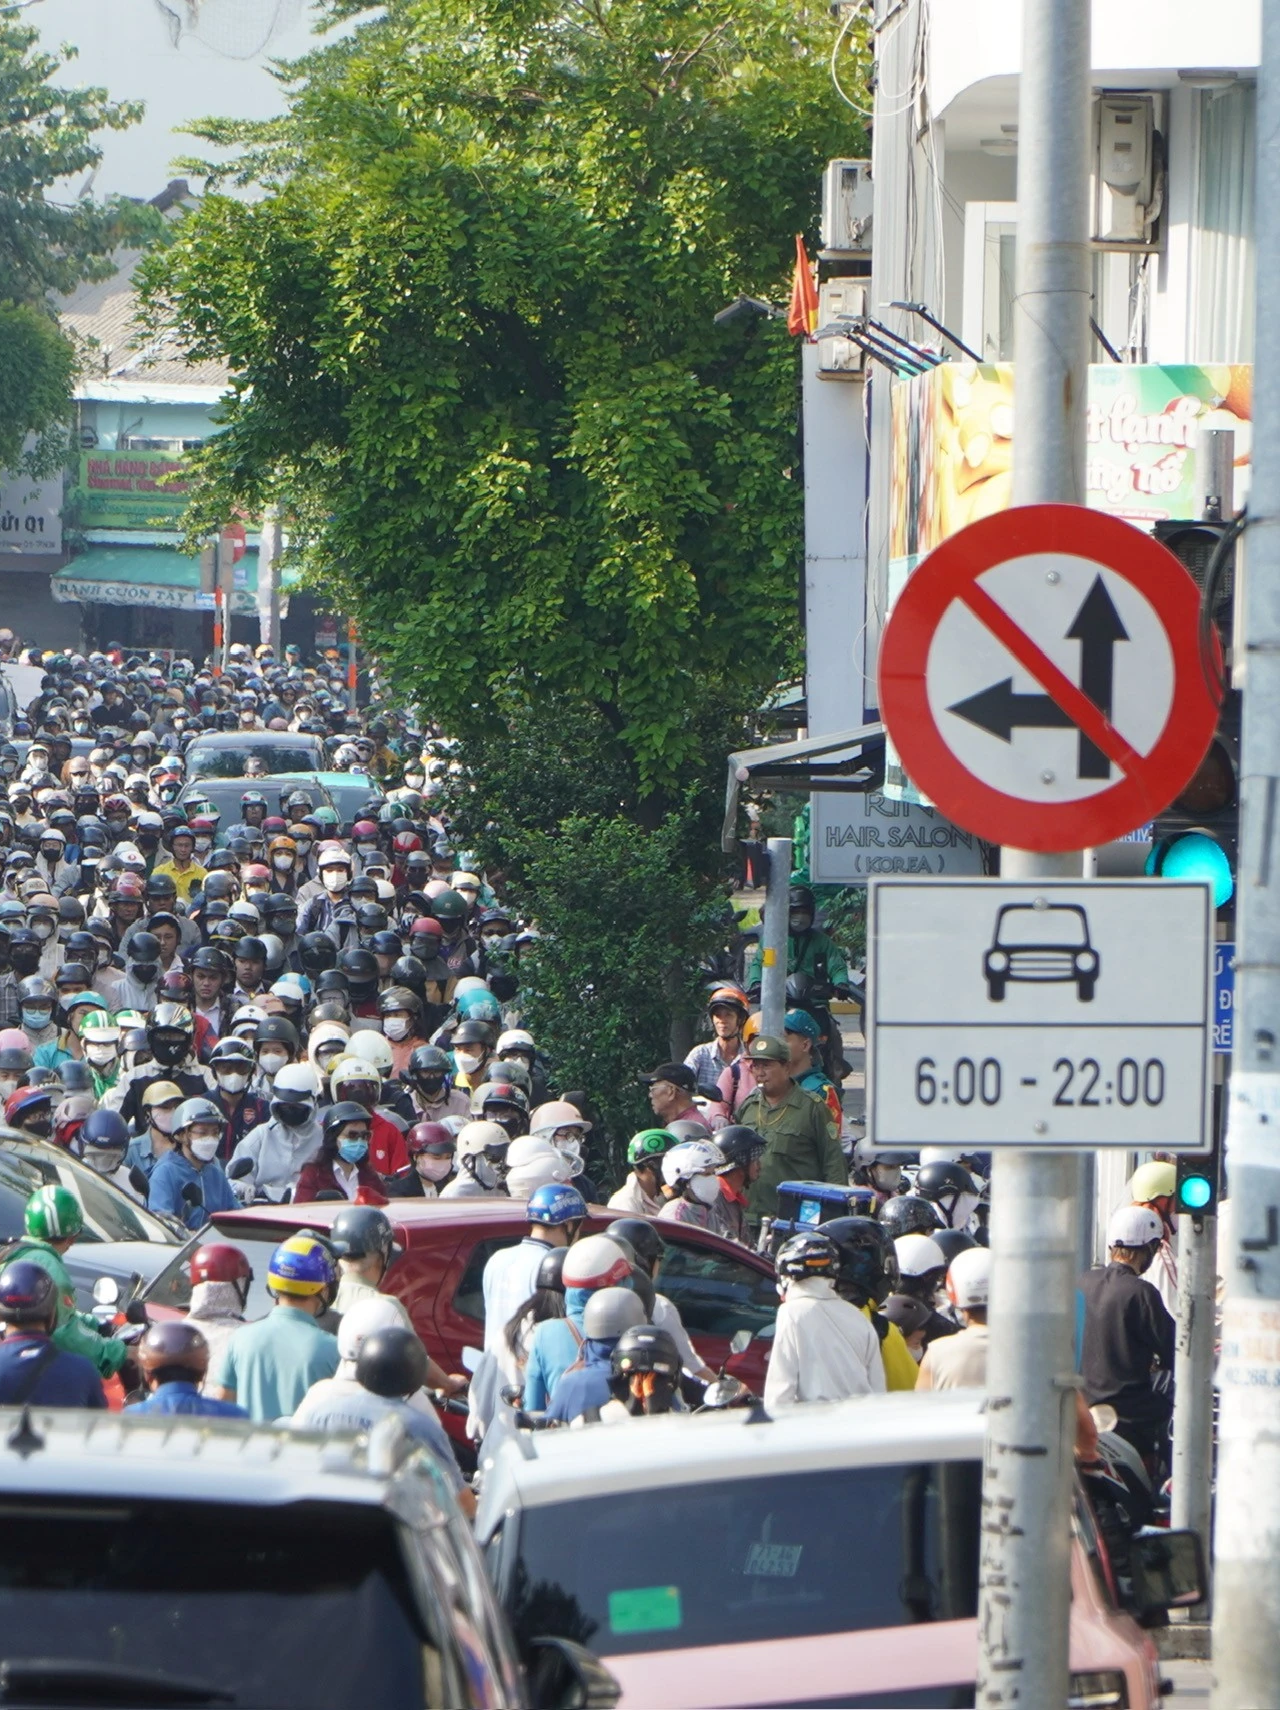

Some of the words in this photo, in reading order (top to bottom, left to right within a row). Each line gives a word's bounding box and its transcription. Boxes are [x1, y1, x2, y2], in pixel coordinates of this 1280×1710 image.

[24, 515, 45, 533] Q1
[825, 825, 884, 848] HAIR
[887, 825, 972, 849] SALON
[915, 1057, 1002, 1107] 6:00
[1021, 1077, 1037, 1087] -
[1052, 1057, 1165, 1107] 22:00
